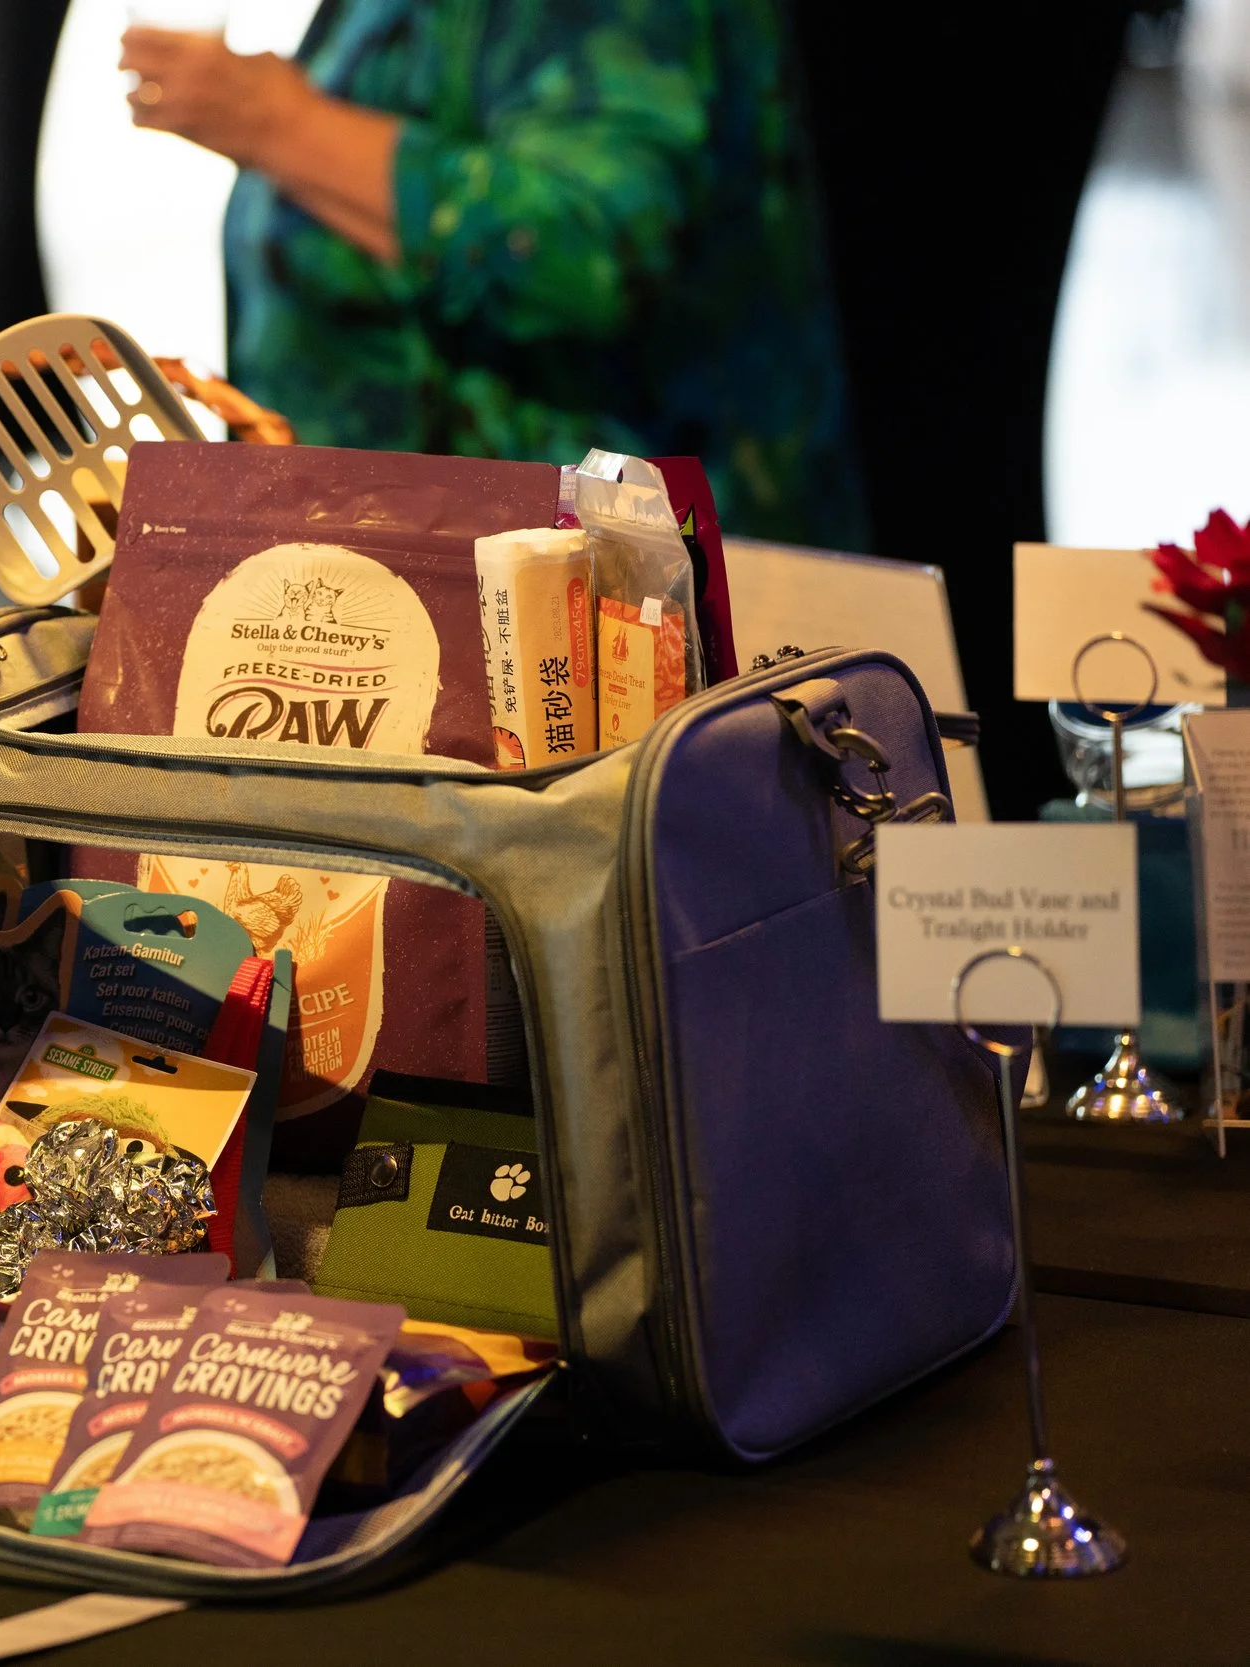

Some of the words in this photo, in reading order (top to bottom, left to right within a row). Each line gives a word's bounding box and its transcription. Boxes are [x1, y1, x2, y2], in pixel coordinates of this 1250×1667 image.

[230, 623, 281, 640] Stella
[283, 624, 298, 641] &
[300, 625, 385, 652] Chewy's
[571, 584, 587, 682] 79cmx45cm
[256, 642, 278, 654] Only
[279, 643, 294, 653] the
[298, 644, 321, 656] good
[323, 646, 349, 658] stuff
[223, 662, 387, 688] FREEZE-DRIED
[206, 686, 391, 750] RAW
[538, 655, 576, 754] 猫砂袋
[887, 886, 964, 911] Crystal
[969, 887, 1014, 910] Bud
[1020, 886, 1073, 910] Vase
[1081, 889, 1120, 911] and
[1012, 918, 1089, 941] Holder
[83, 943, 185, 966] Katzen-Garnitur
[90, 963, 112, 979] Cat
[114, 963, 136, 977] set
[96, 983, 119, 998] Set
[121, 985, 150, 998] voor
[152, 986, 190, 1012] katten
[102, 1001, 165, 1023] Ensemble
[166, 1013, 196, 1033] pour
[46, 1048, 82, 1070] SESAME
[80, 1060, 114, 1080] STREET
[449, 1205, 475, 1222] Cat
[480, 1208, 519, 1229] Litter
[8, 1326, 98, 1365] CRAV
[189, 1332, 359, 1386] Carnivore
[95, 1360, 170, 1399] CRA
[172, 1360, 344, 1420] CRAVINGS
